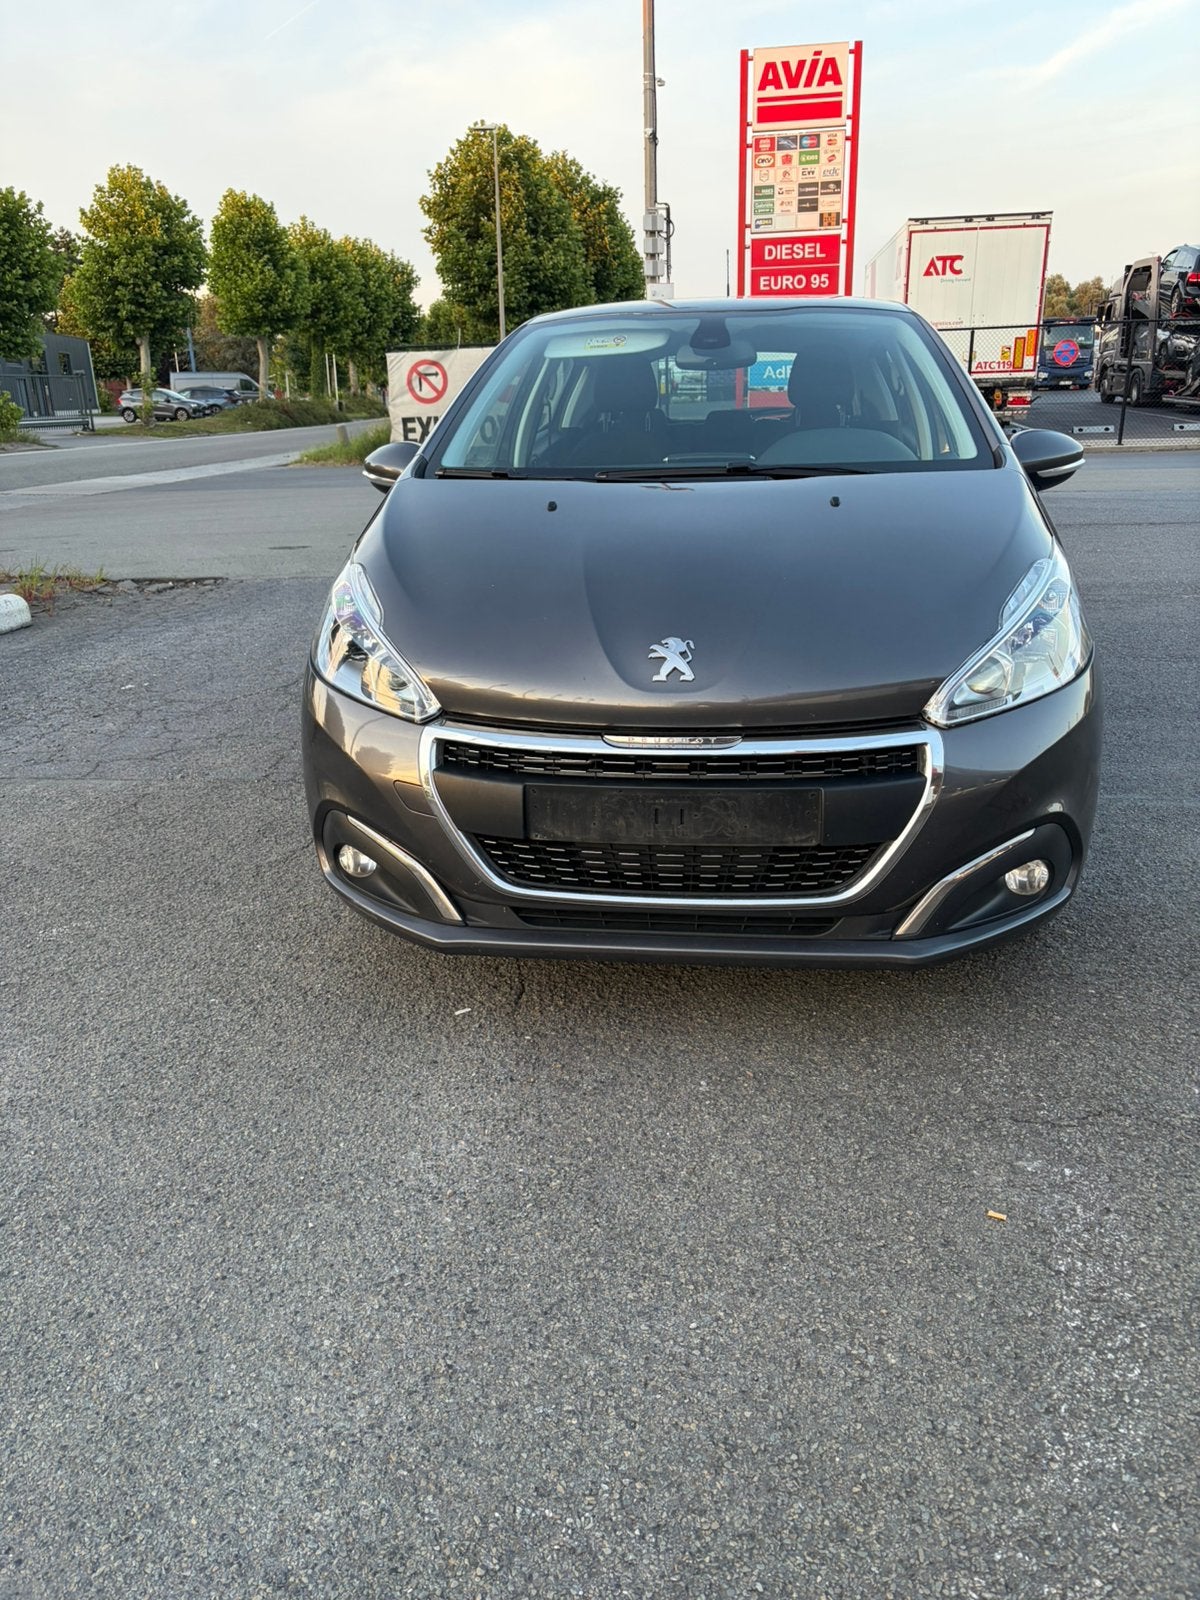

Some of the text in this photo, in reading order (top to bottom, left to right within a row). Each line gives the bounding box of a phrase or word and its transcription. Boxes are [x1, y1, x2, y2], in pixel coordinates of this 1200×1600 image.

[757, 157, 771, 165] DKV
[764, 243, 826, 260] DIESEL
[922, 254, 965, 277] ATC
[760, 273, 829, 290] EURO 95
[975, 360, 1013, 370] ATC119
[401, 416, 440, 443] EX
